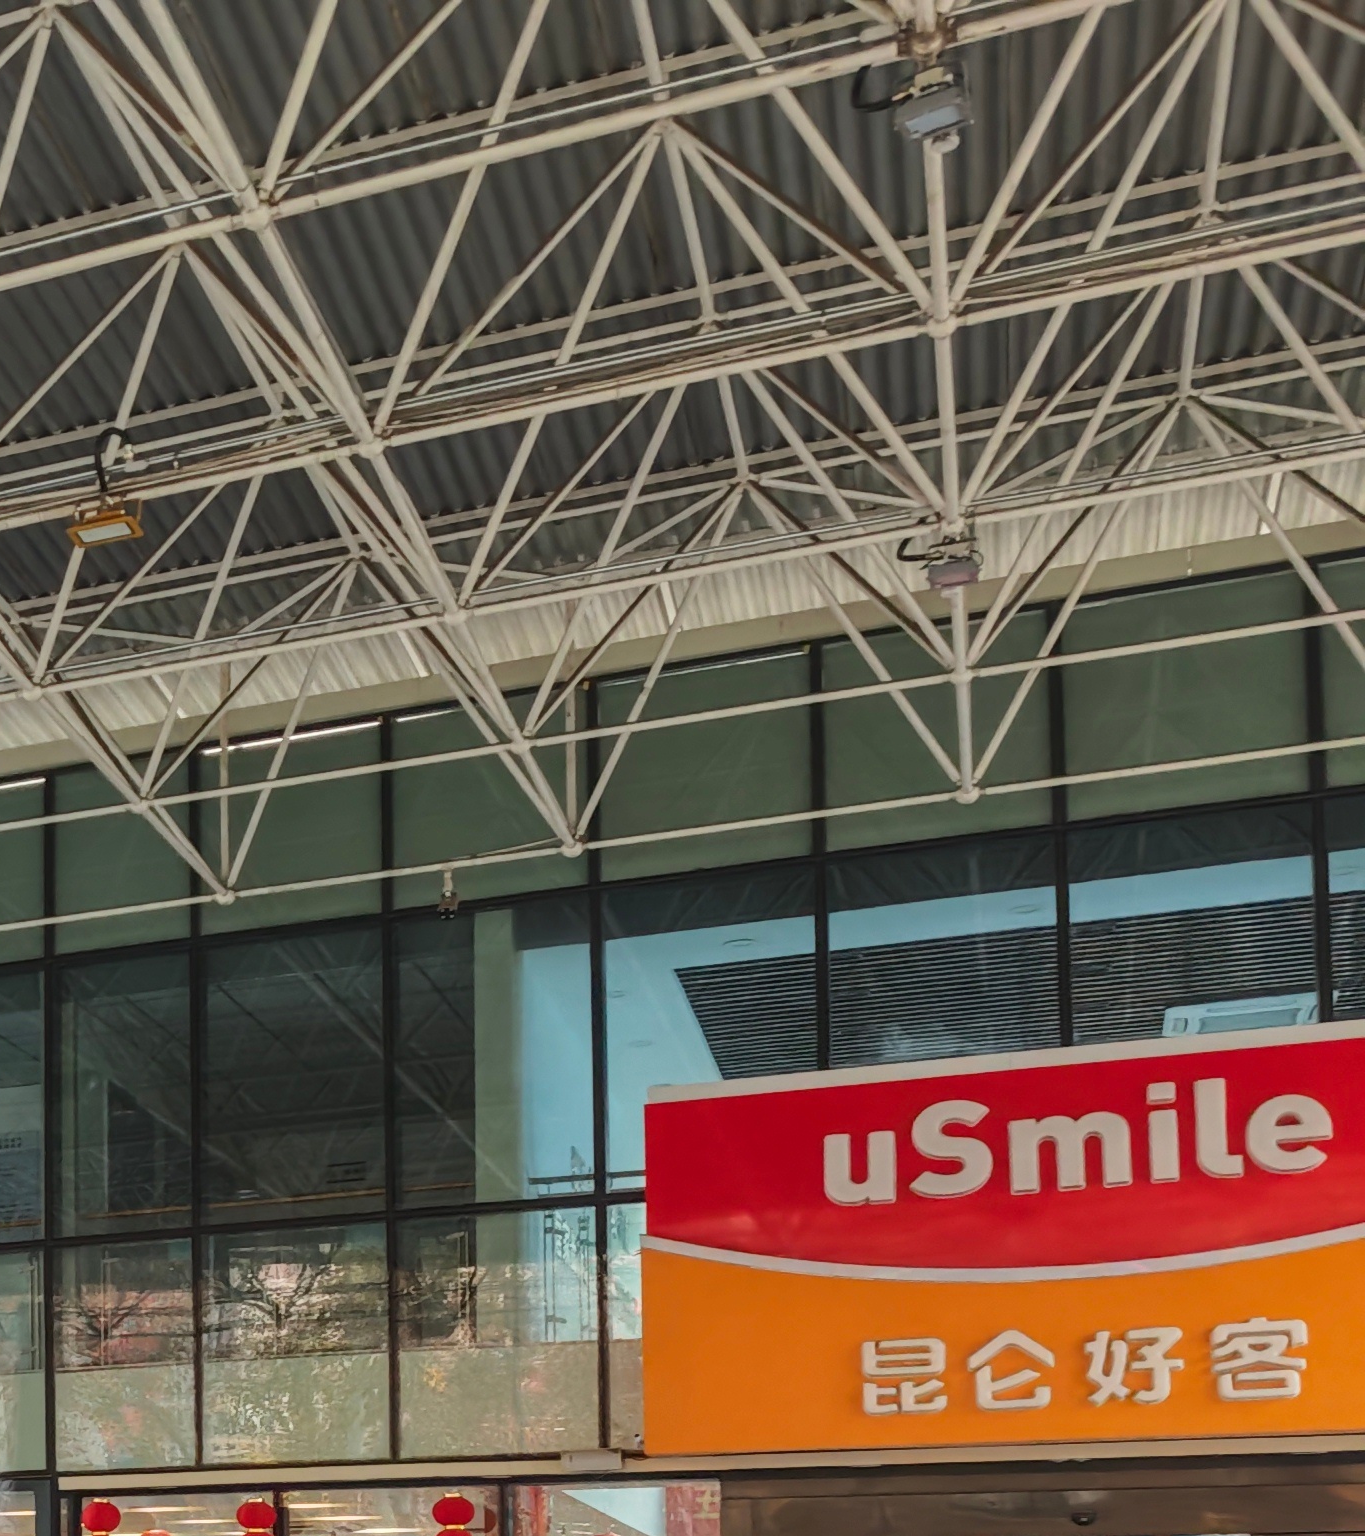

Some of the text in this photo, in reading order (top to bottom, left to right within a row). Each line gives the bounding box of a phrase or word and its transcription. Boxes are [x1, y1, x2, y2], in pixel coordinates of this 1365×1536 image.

[823, 1077, 1335, 1207] uSmile
[860, 1317, 1310, 1416] 昆仑好客
